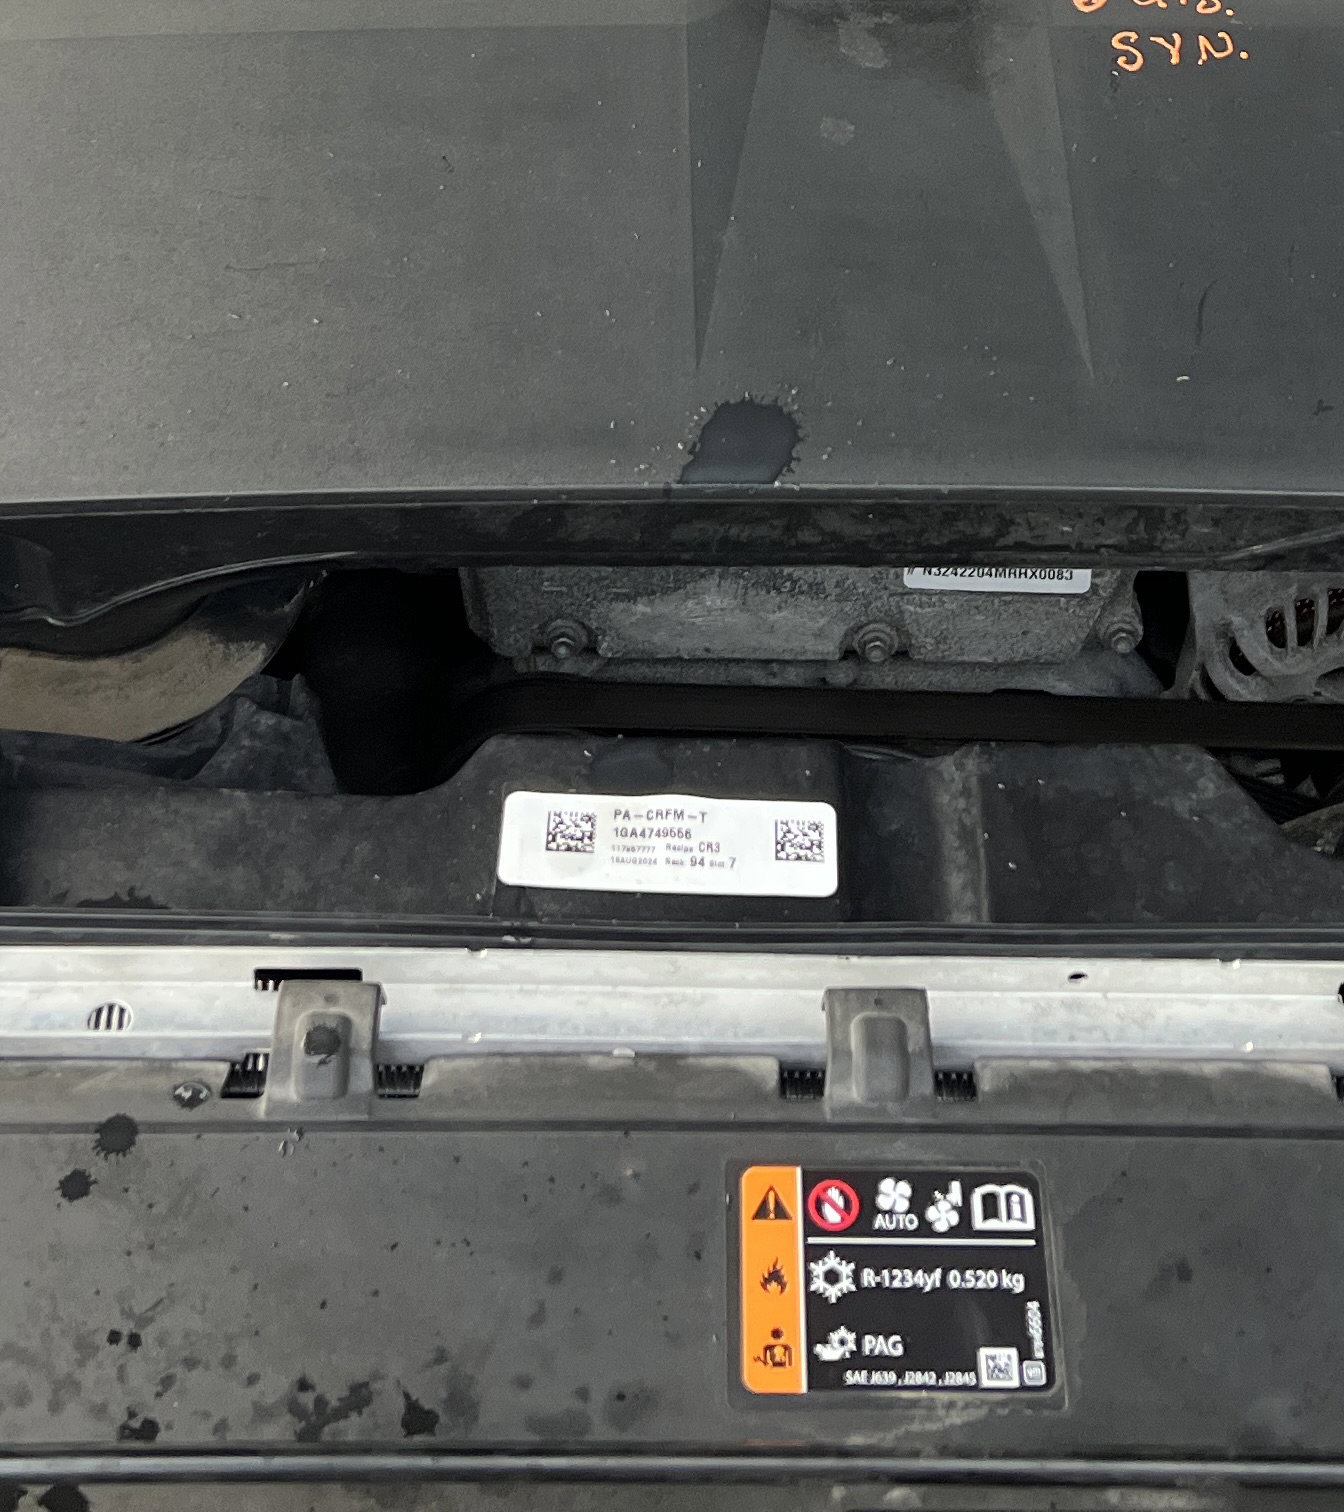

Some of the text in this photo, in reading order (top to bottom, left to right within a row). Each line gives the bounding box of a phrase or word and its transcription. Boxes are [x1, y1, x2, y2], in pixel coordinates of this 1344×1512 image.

[1111, 30, 1249, 72] SYN.
[690, 855, 705, 868] 94
[728, 856, 737, 869] 7
[872, 1213, 919, 1231] AUTO
[860, 1267, 1025, 1294] R-1234yf 0.520 kg
[861, 1334, 905, 1357] PAG
[843, 1369, 869, 1386] SAE
